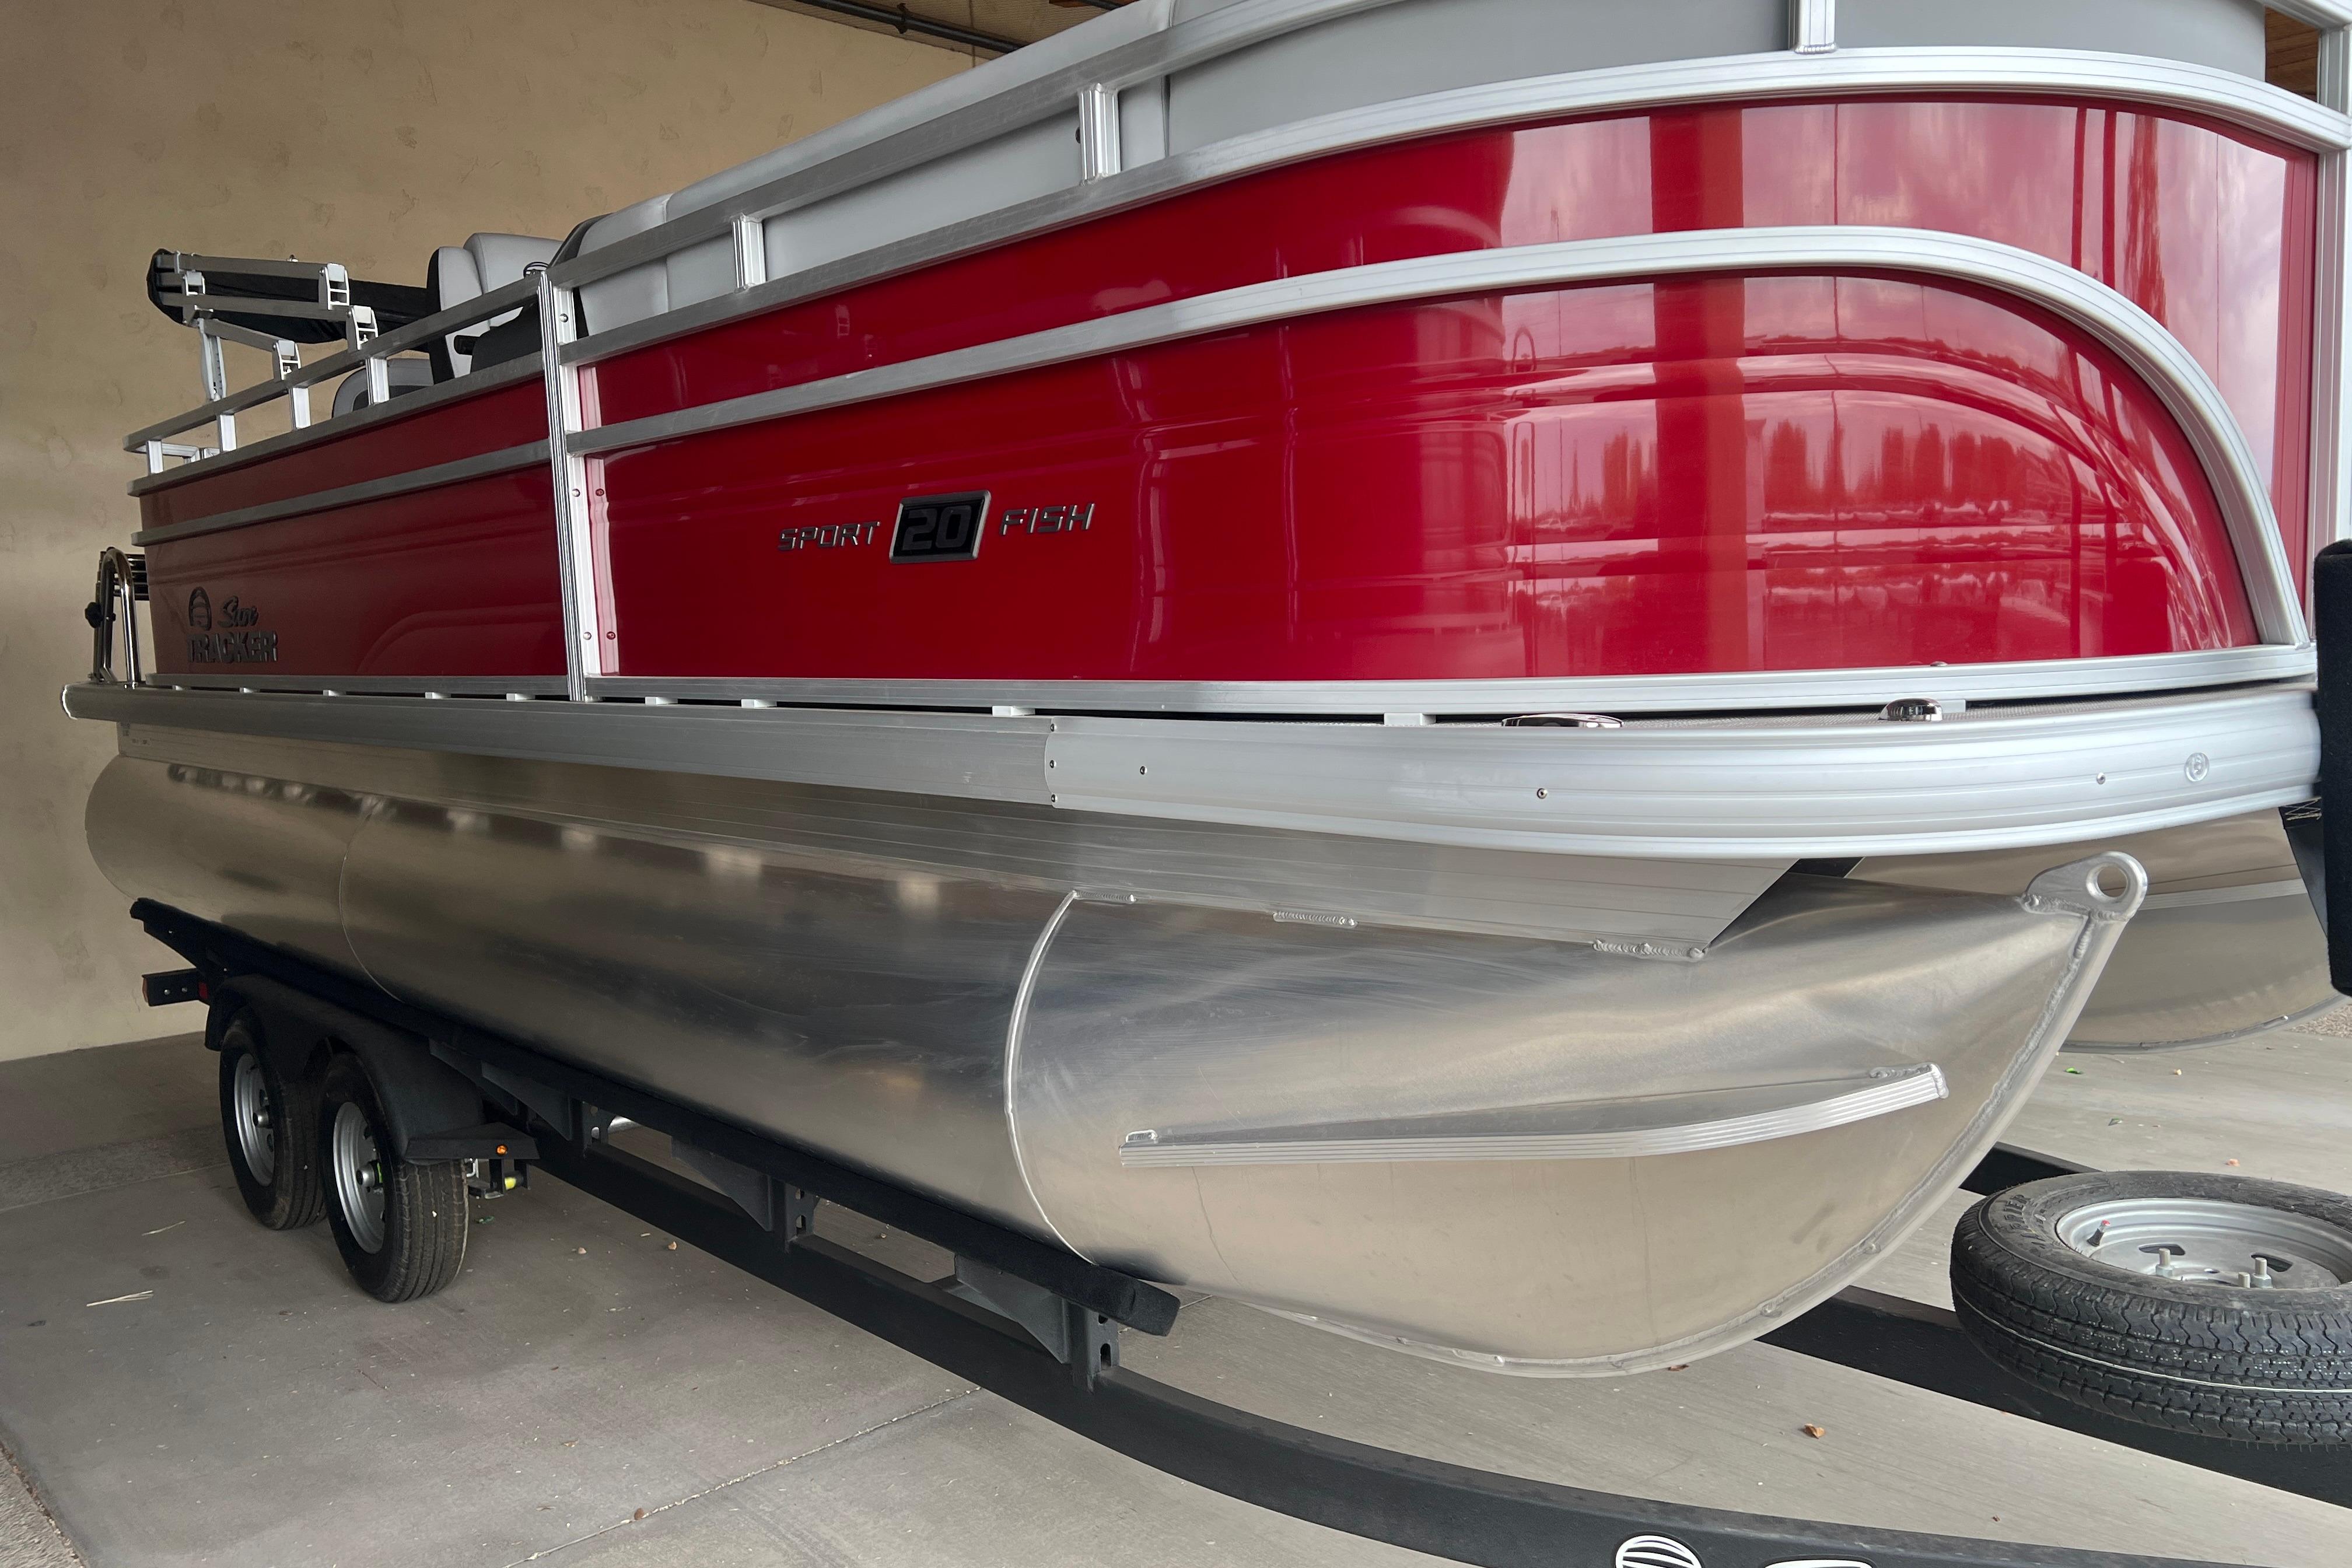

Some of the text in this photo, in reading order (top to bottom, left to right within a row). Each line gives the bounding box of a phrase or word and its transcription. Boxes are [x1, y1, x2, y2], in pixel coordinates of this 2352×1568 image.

[779, 503, 1096, 550] SPORT 20 FISH
[218, 595, 258, 628] Sun
[187, 631, 278, 663] TRACKER
